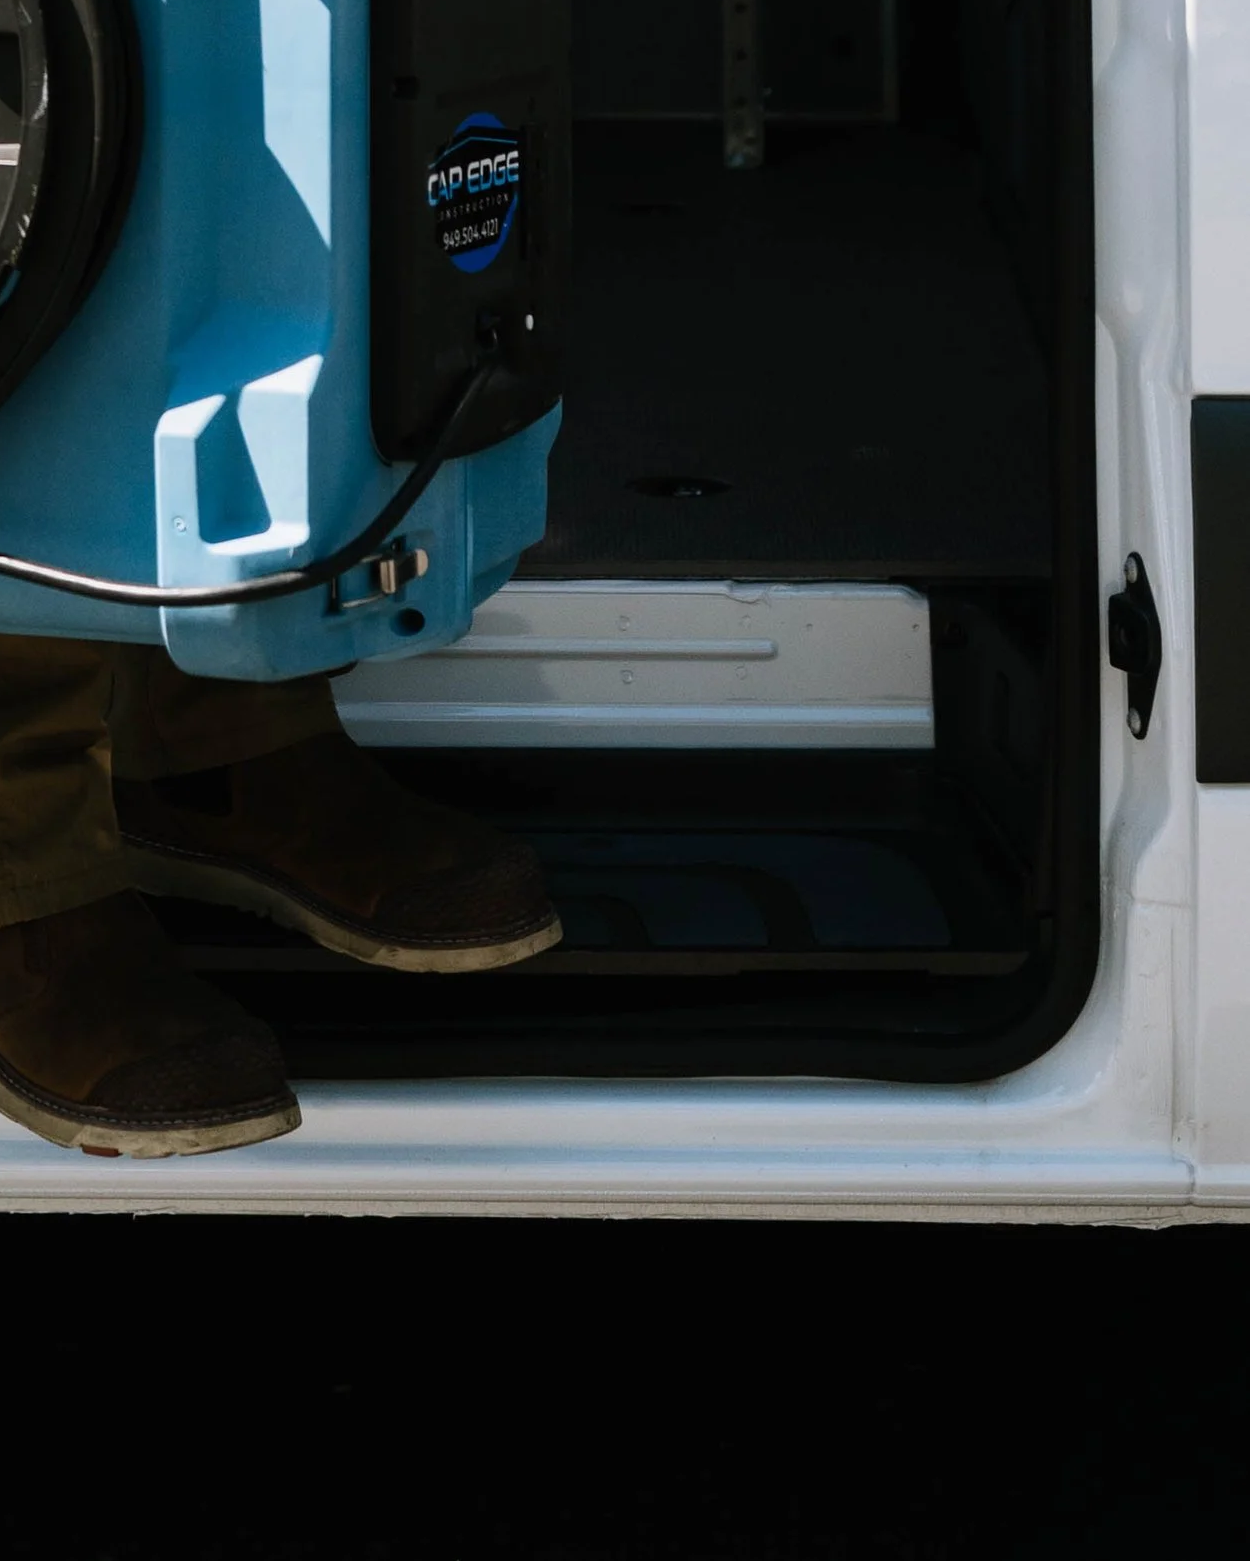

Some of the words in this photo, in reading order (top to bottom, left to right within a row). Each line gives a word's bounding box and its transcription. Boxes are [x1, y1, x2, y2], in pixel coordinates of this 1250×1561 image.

[427, 166, 463, 207] CAP
[467, 150, 519, 194] EDGE
[442, 217, 499, 251] 949.504.4121
